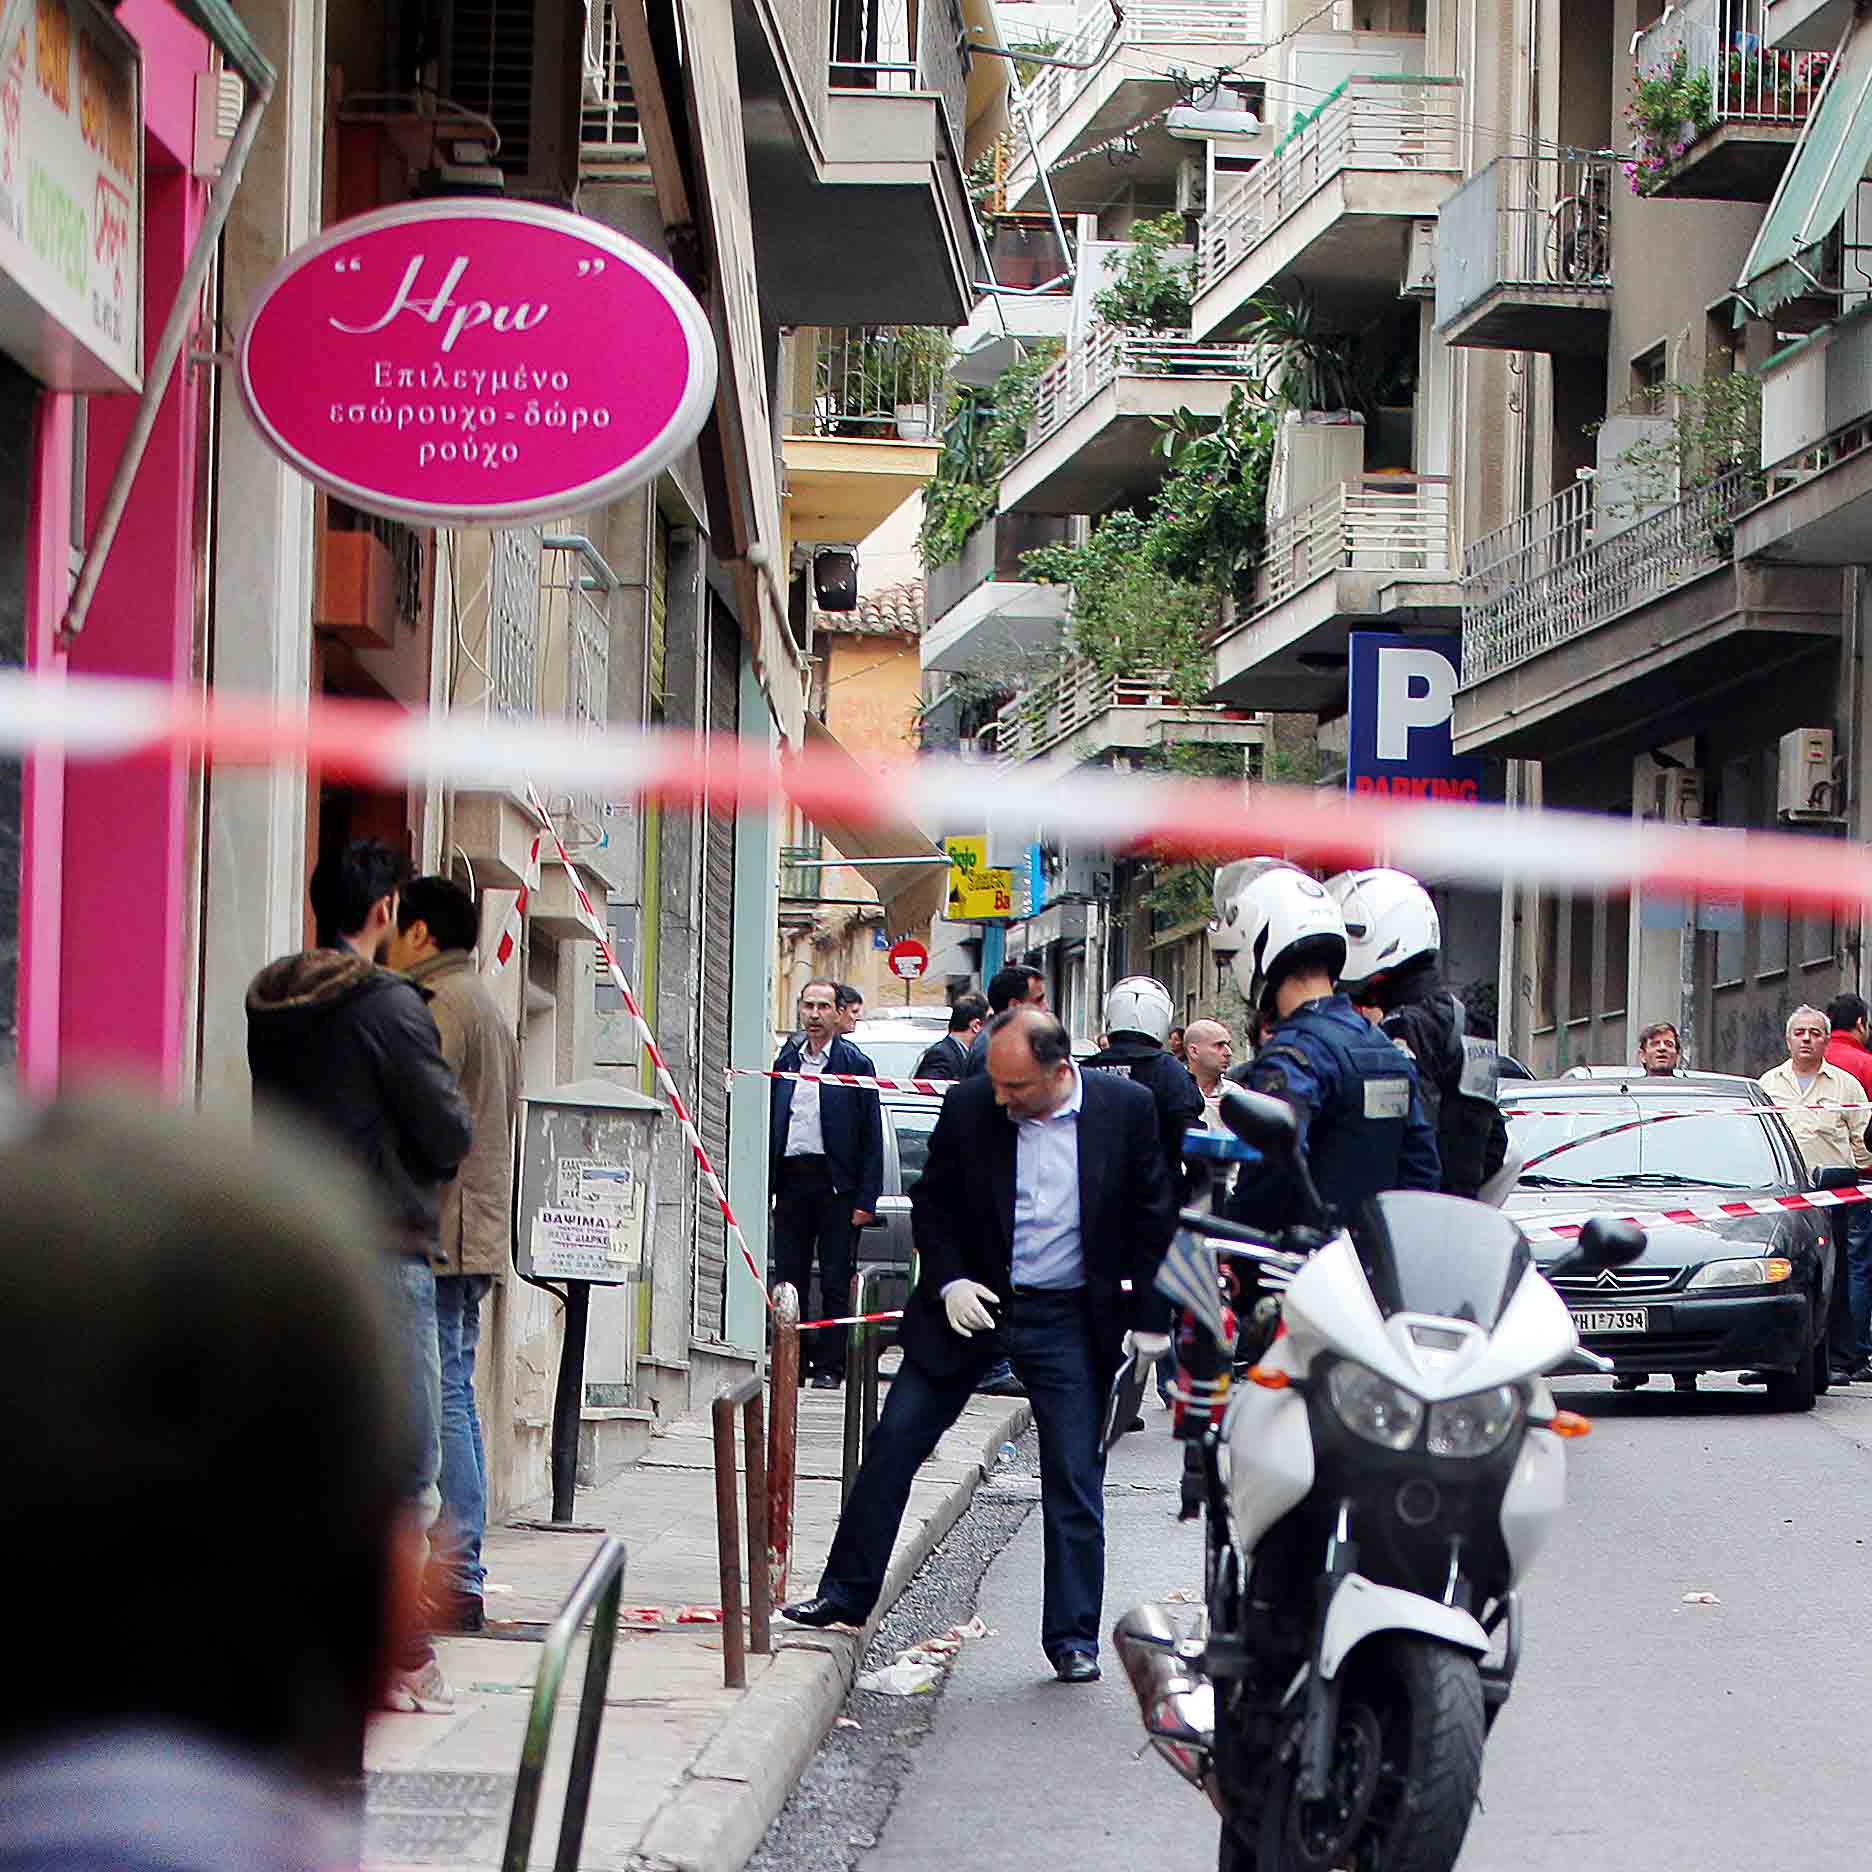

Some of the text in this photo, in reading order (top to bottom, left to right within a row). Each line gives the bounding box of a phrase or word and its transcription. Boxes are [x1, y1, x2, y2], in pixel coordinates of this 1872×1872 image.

[373, 360, 570, 396] Επιλεγμένο
[419, 435, 520, 469] ρούχο
[1377, 648, 1460, 760] P
